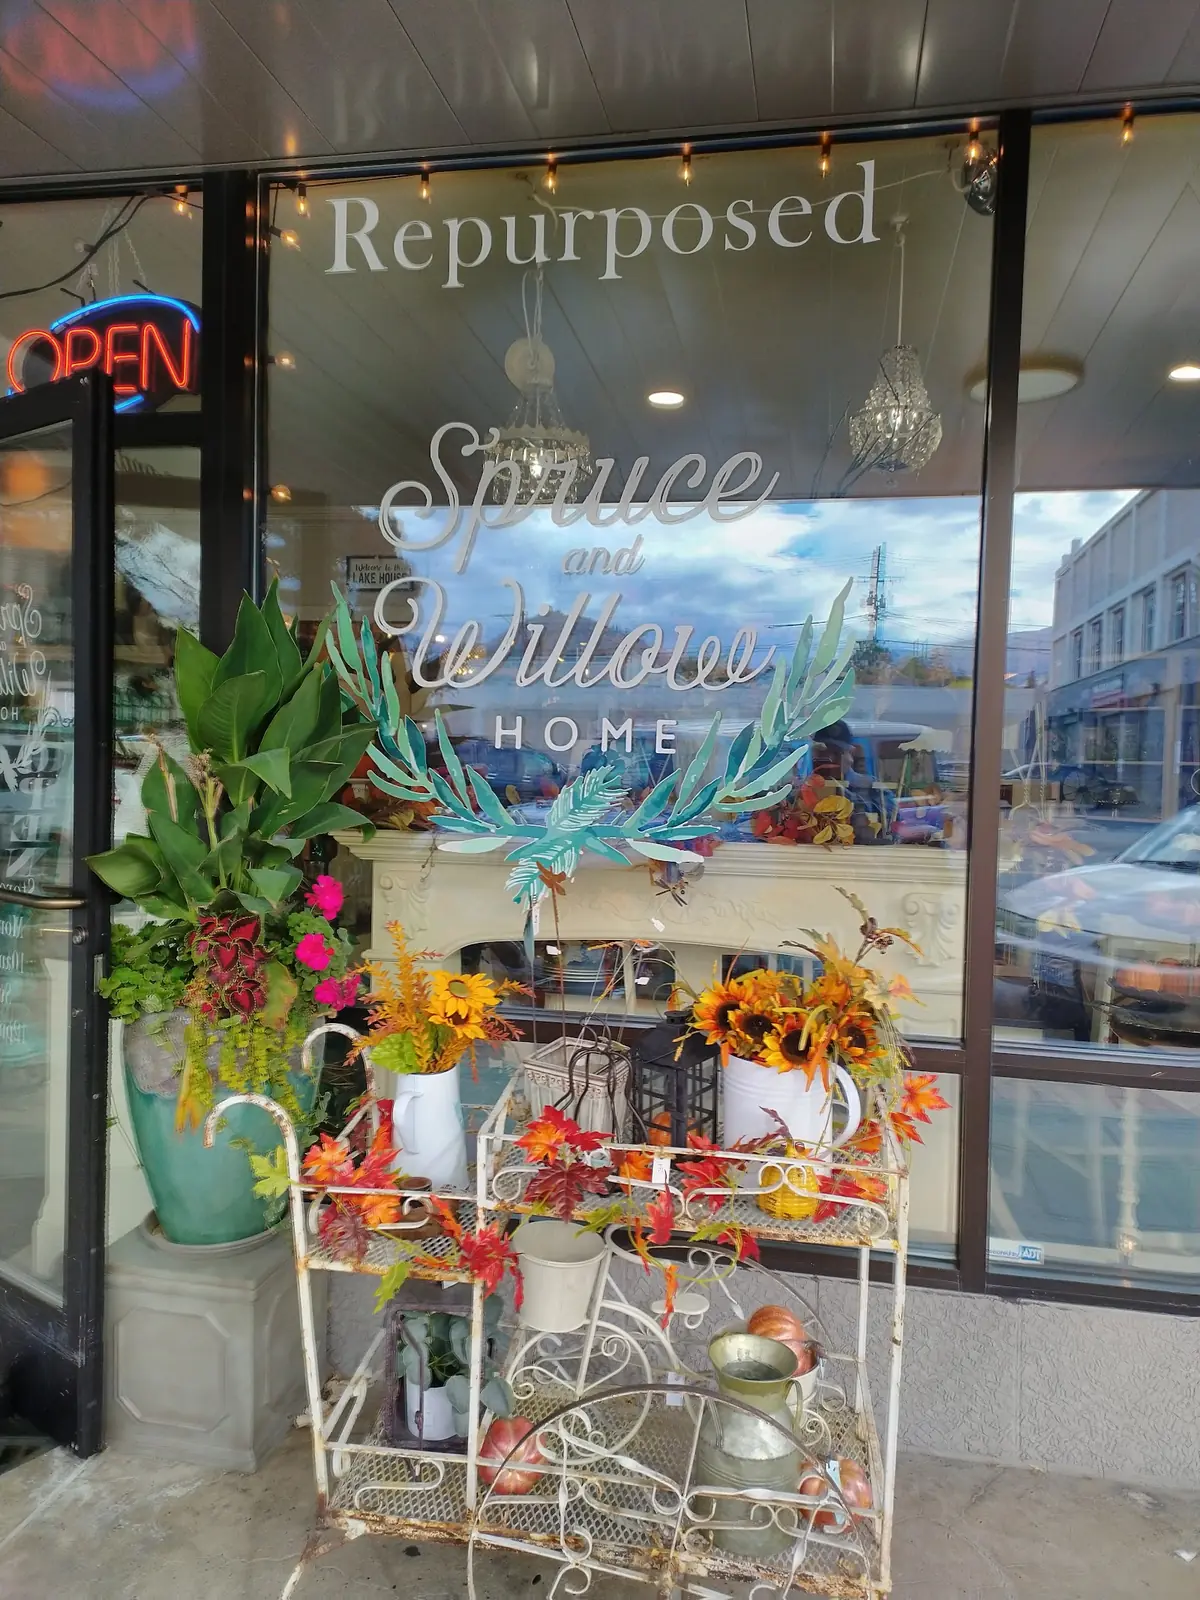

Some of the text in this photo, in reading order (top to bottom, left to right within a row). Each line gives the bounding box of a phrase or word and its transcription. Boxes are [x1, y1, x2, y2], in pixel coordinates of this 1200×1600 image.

[325, 160, 881, 289] Repurposed
[7, 319, 192, 394] OPEN
[378, 421, 780, 574] Spruce
[352, 571, 377, 584] LAKE
[562, 533, 646, 576] and
[373, 576, 777, 691] Willow
[494, 715, 678, 755] HOME
[1023, 1247, 1042, 1260] ADT
